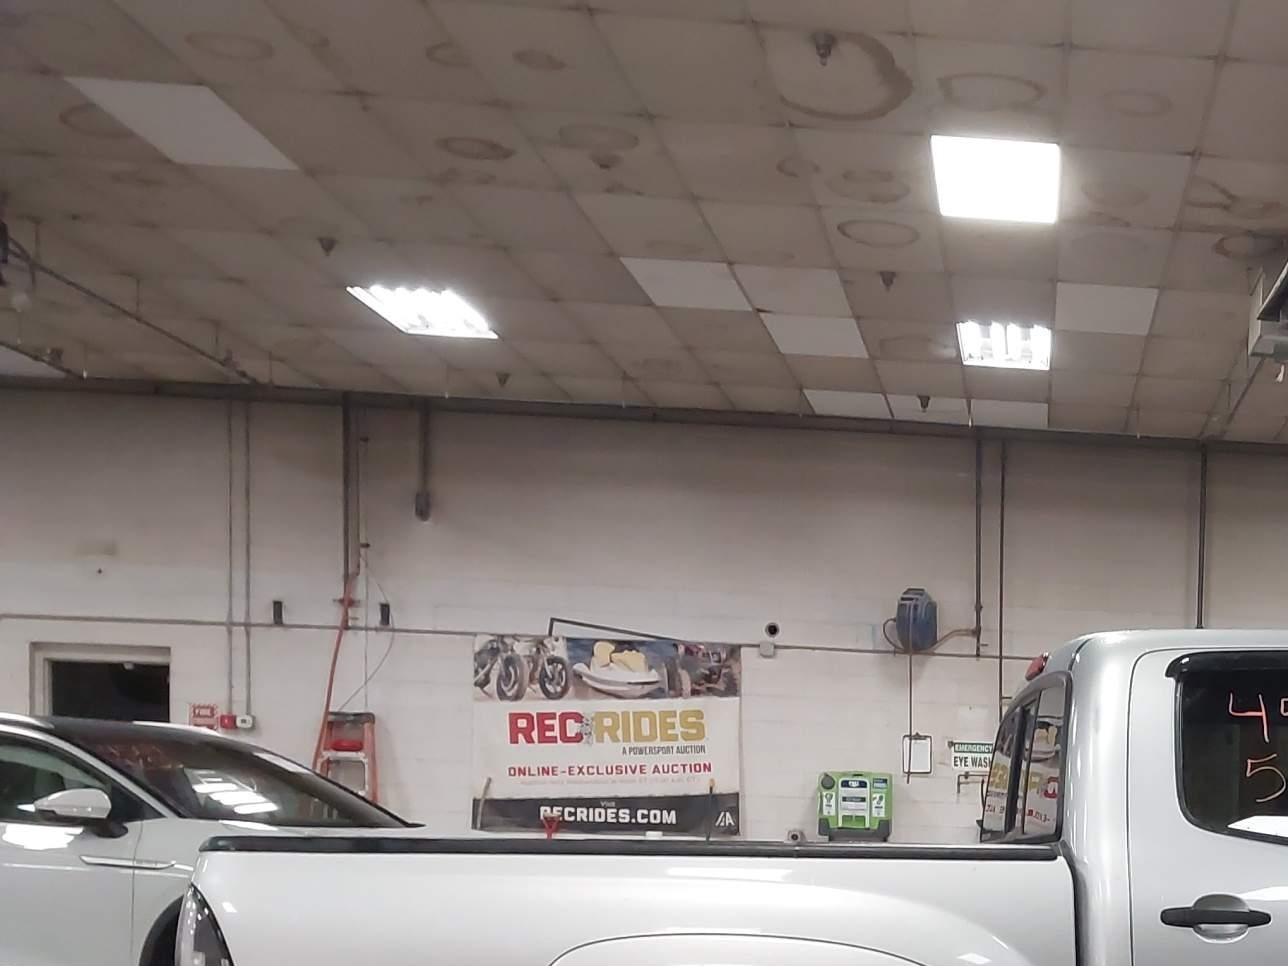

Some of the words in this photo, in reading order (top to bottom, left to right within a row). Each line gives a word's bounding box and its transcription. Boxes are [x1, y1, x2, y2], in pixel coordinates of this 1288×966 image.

[508, 712, 584, 745] REC
[593, 709, 706, 744] RIDES
[629, 746, 674, 755] POWERSPORT
[676, 744, 706, 754] AUCTION
[954, 744, 993, 752] EMERGENCY
[954, 756, 969, 767] EYE
[508, 765, 647, 777] ONLINE-EXCLUSIVE
[652, 762, 712, 775] AUCTION
